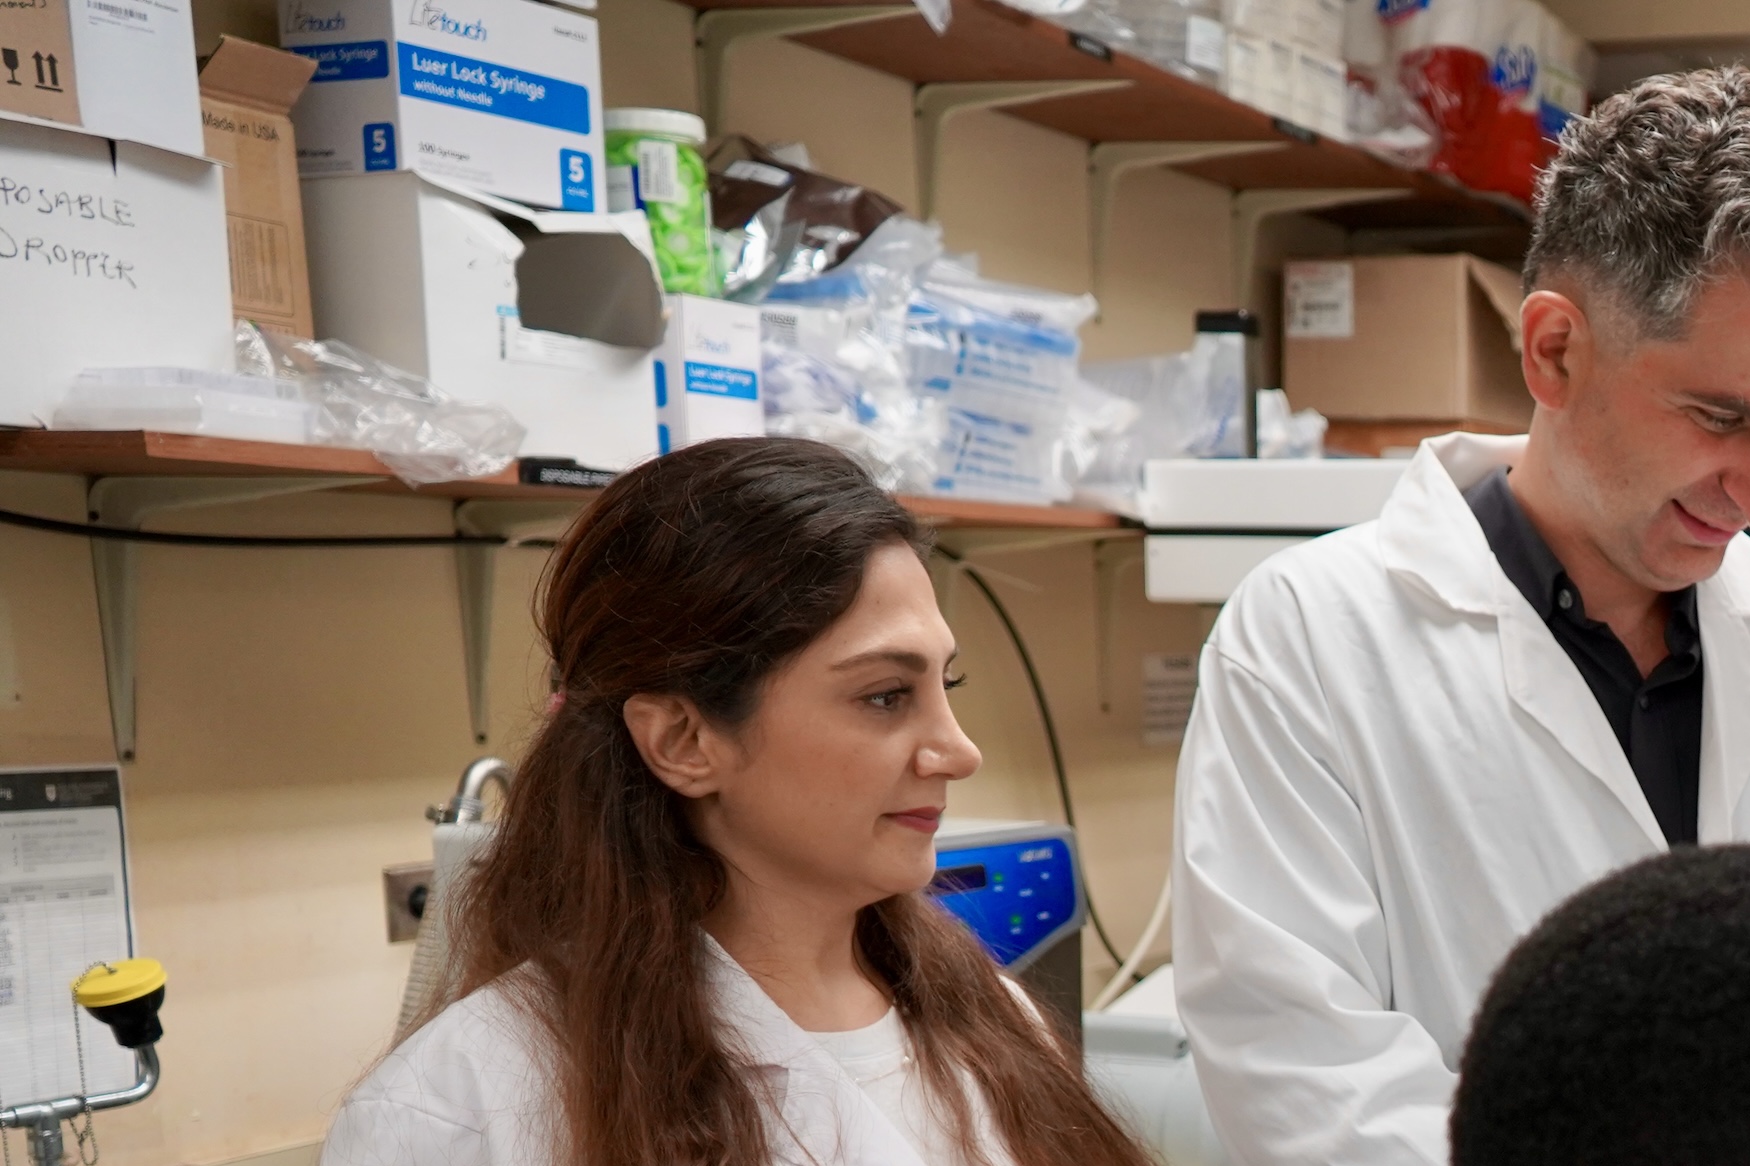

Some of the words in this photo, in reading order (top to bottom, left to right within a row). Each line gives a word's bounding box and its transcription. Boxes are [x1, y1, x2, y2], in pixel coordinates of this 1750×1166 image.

[411, 51, 448, 76] Luer
[450, 60, 488, 86] Lock
[489, 70, 546, 102] Syringe
[412, 78, 456, 99] without
[457, 86, 494, 107] Needle
[201, 110, 235, 133] Made
[239, 124, 249, 136] in
[251, 121, 281, 141] USA
[372, 128, 387, 153] 5
[567, 155, 585, 183] 5
